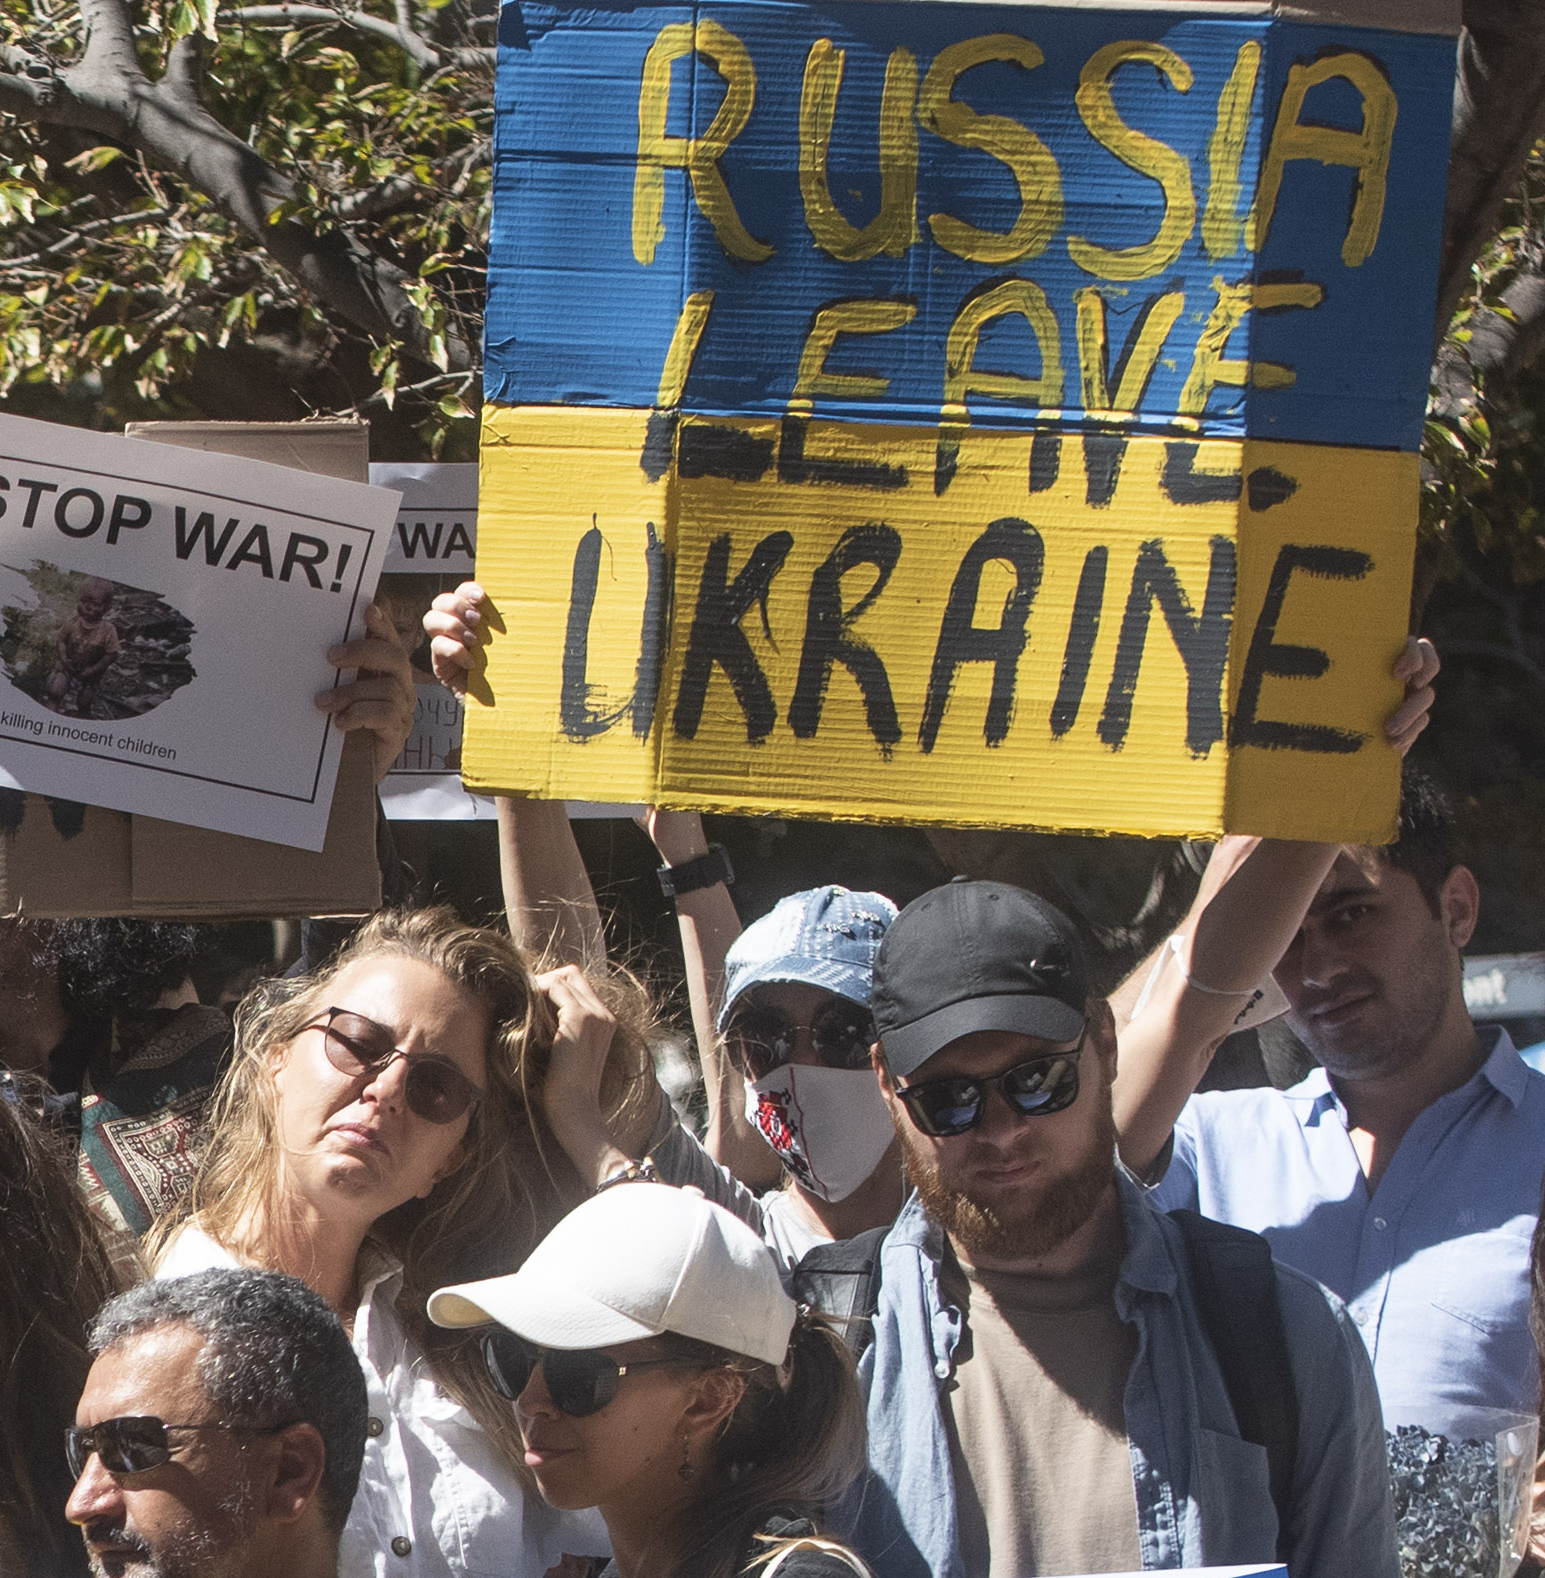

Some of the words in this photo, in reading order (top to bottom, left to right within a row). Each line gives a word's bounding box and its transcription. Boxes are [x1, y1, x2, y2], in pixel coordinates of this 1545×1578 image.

[632, 18, 1397, 280] RUSSIA
[641, 275, 1324, 510] LEAVE
[174, 505, 353, 594] WAR!
[560, 512, 1375, 760] UKRAINE
[0, 710, 44, 736] killing
[48, 721, 114, 747] innocent
[117, 737, 177, 760] children
